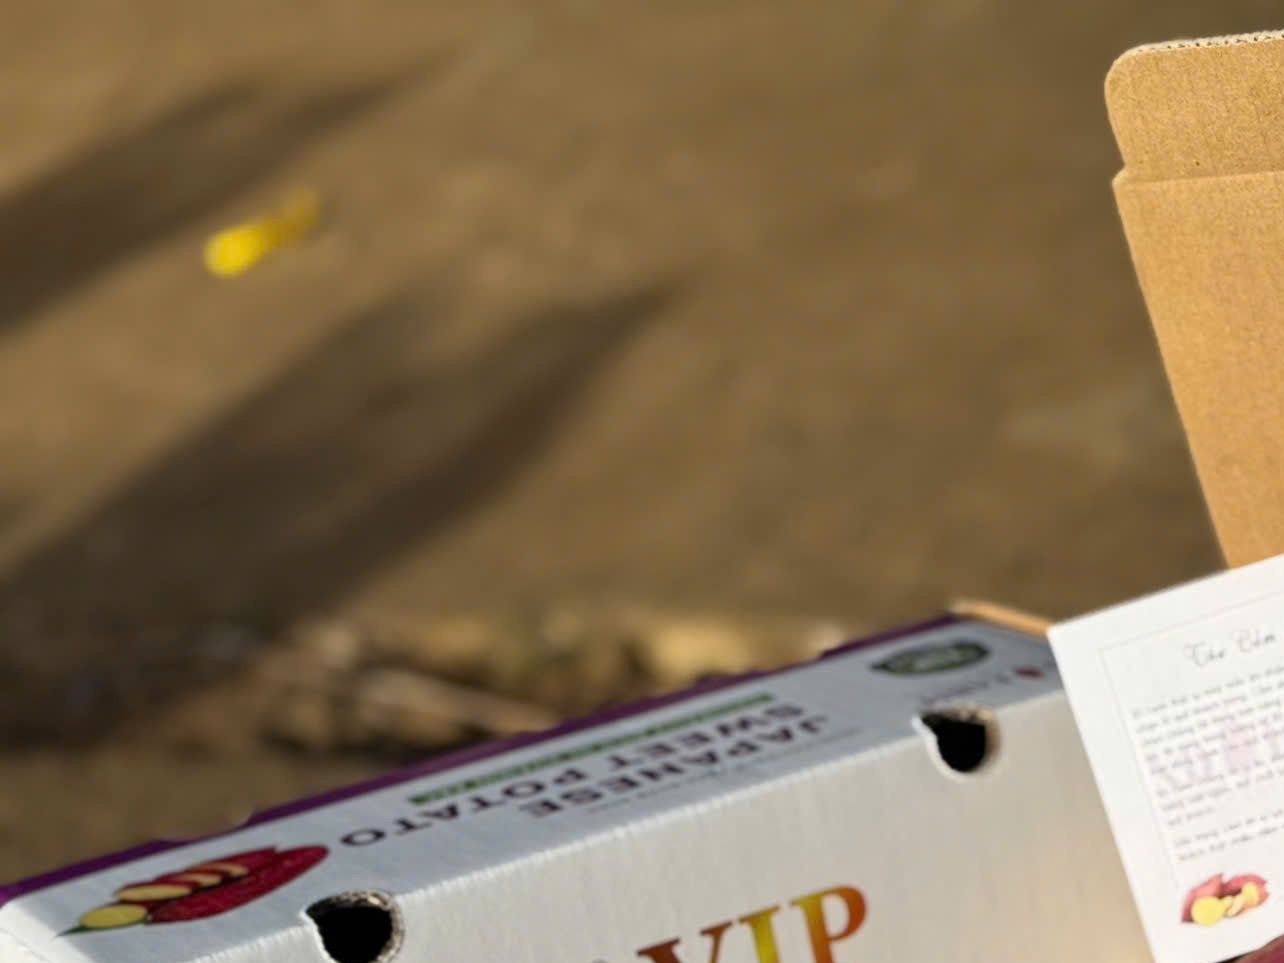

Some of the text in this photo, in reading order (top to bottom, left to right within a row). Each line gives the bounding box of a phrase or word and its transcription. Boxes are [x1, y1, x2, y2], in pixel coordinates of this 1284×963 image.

[517, 713, 829, 819] JAPANESE
[608, 704, 803, 771] SWEET
[340, 768, 587, 848] POTATO
